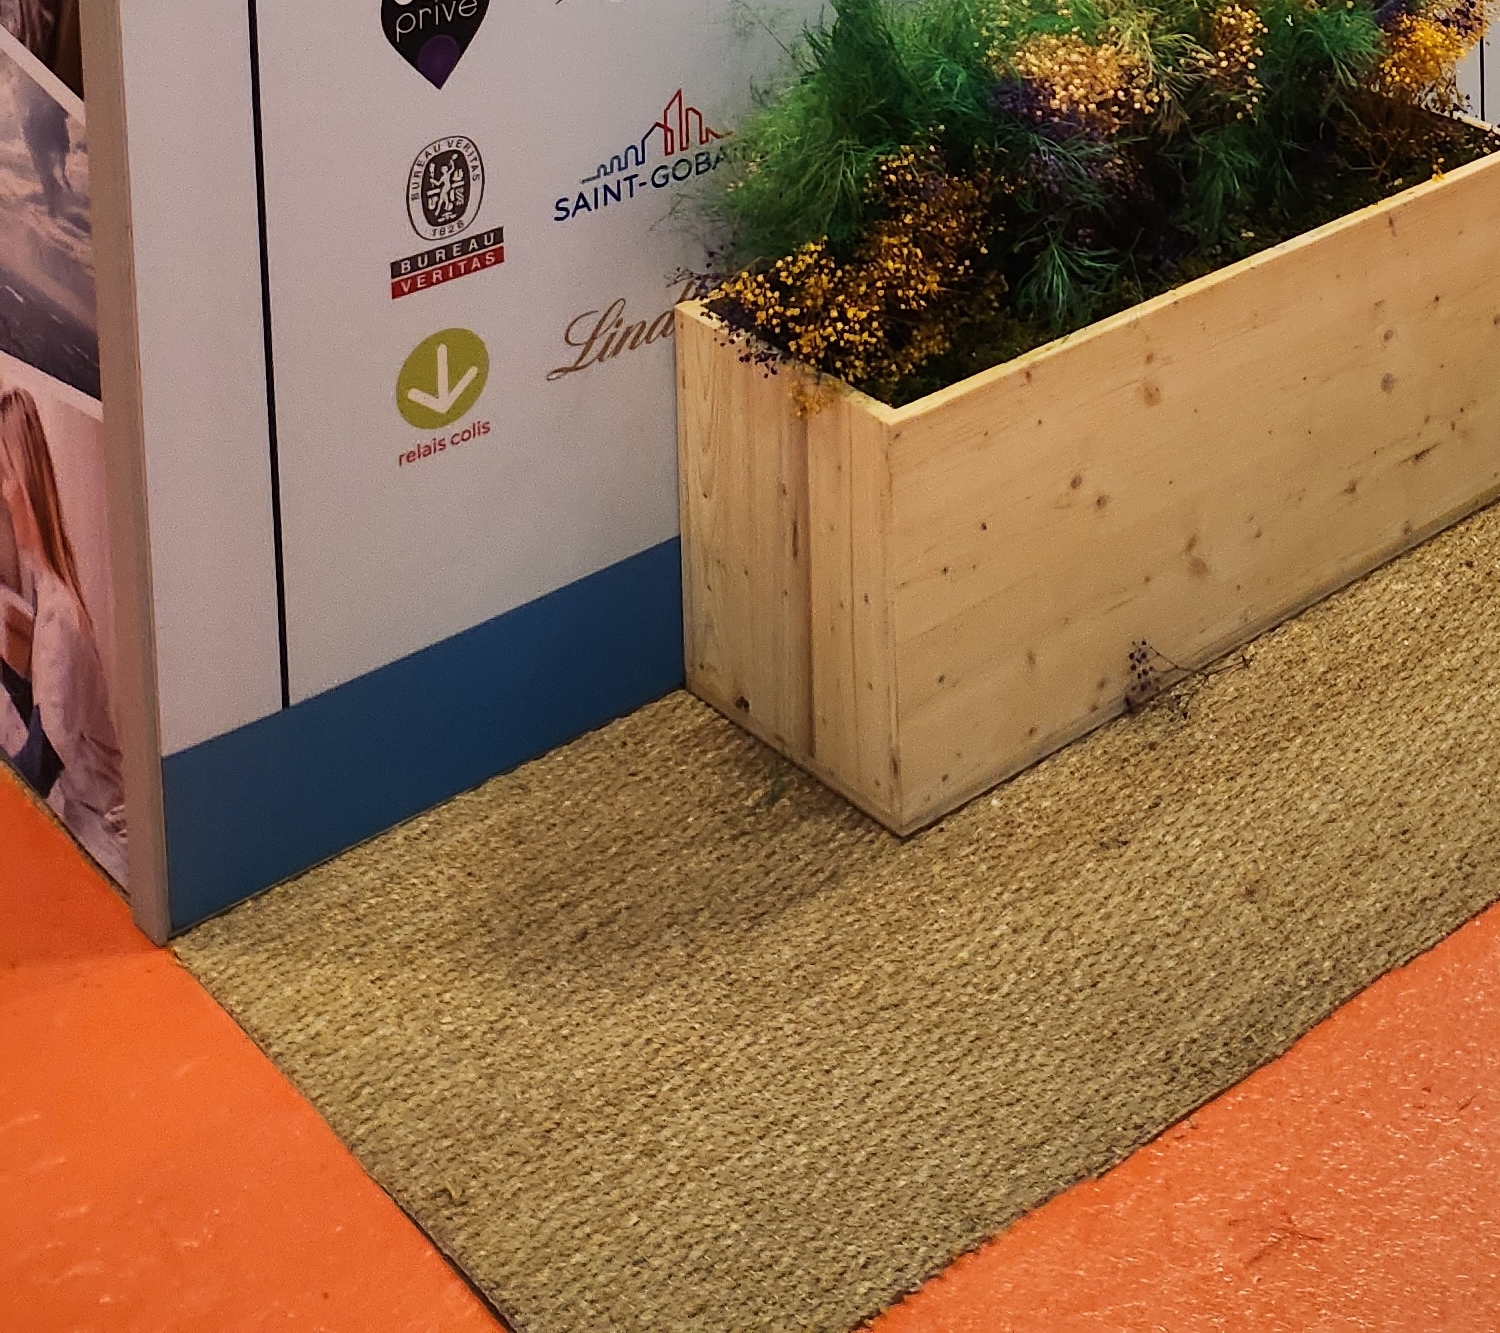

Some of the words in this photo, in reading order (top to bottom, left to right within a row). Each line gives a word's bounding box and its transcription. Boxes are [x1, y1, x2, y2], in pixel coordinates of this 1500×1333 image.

[447, 138, 482, 182] VERITAS
[400, 231, 495, 274] BUREAU
[400, 251, 496, 294] VERITAS
[547, 281, 698, 381] Lind
[398, 437, 447, 467] relais
[450, 420, 491, 446] colis
